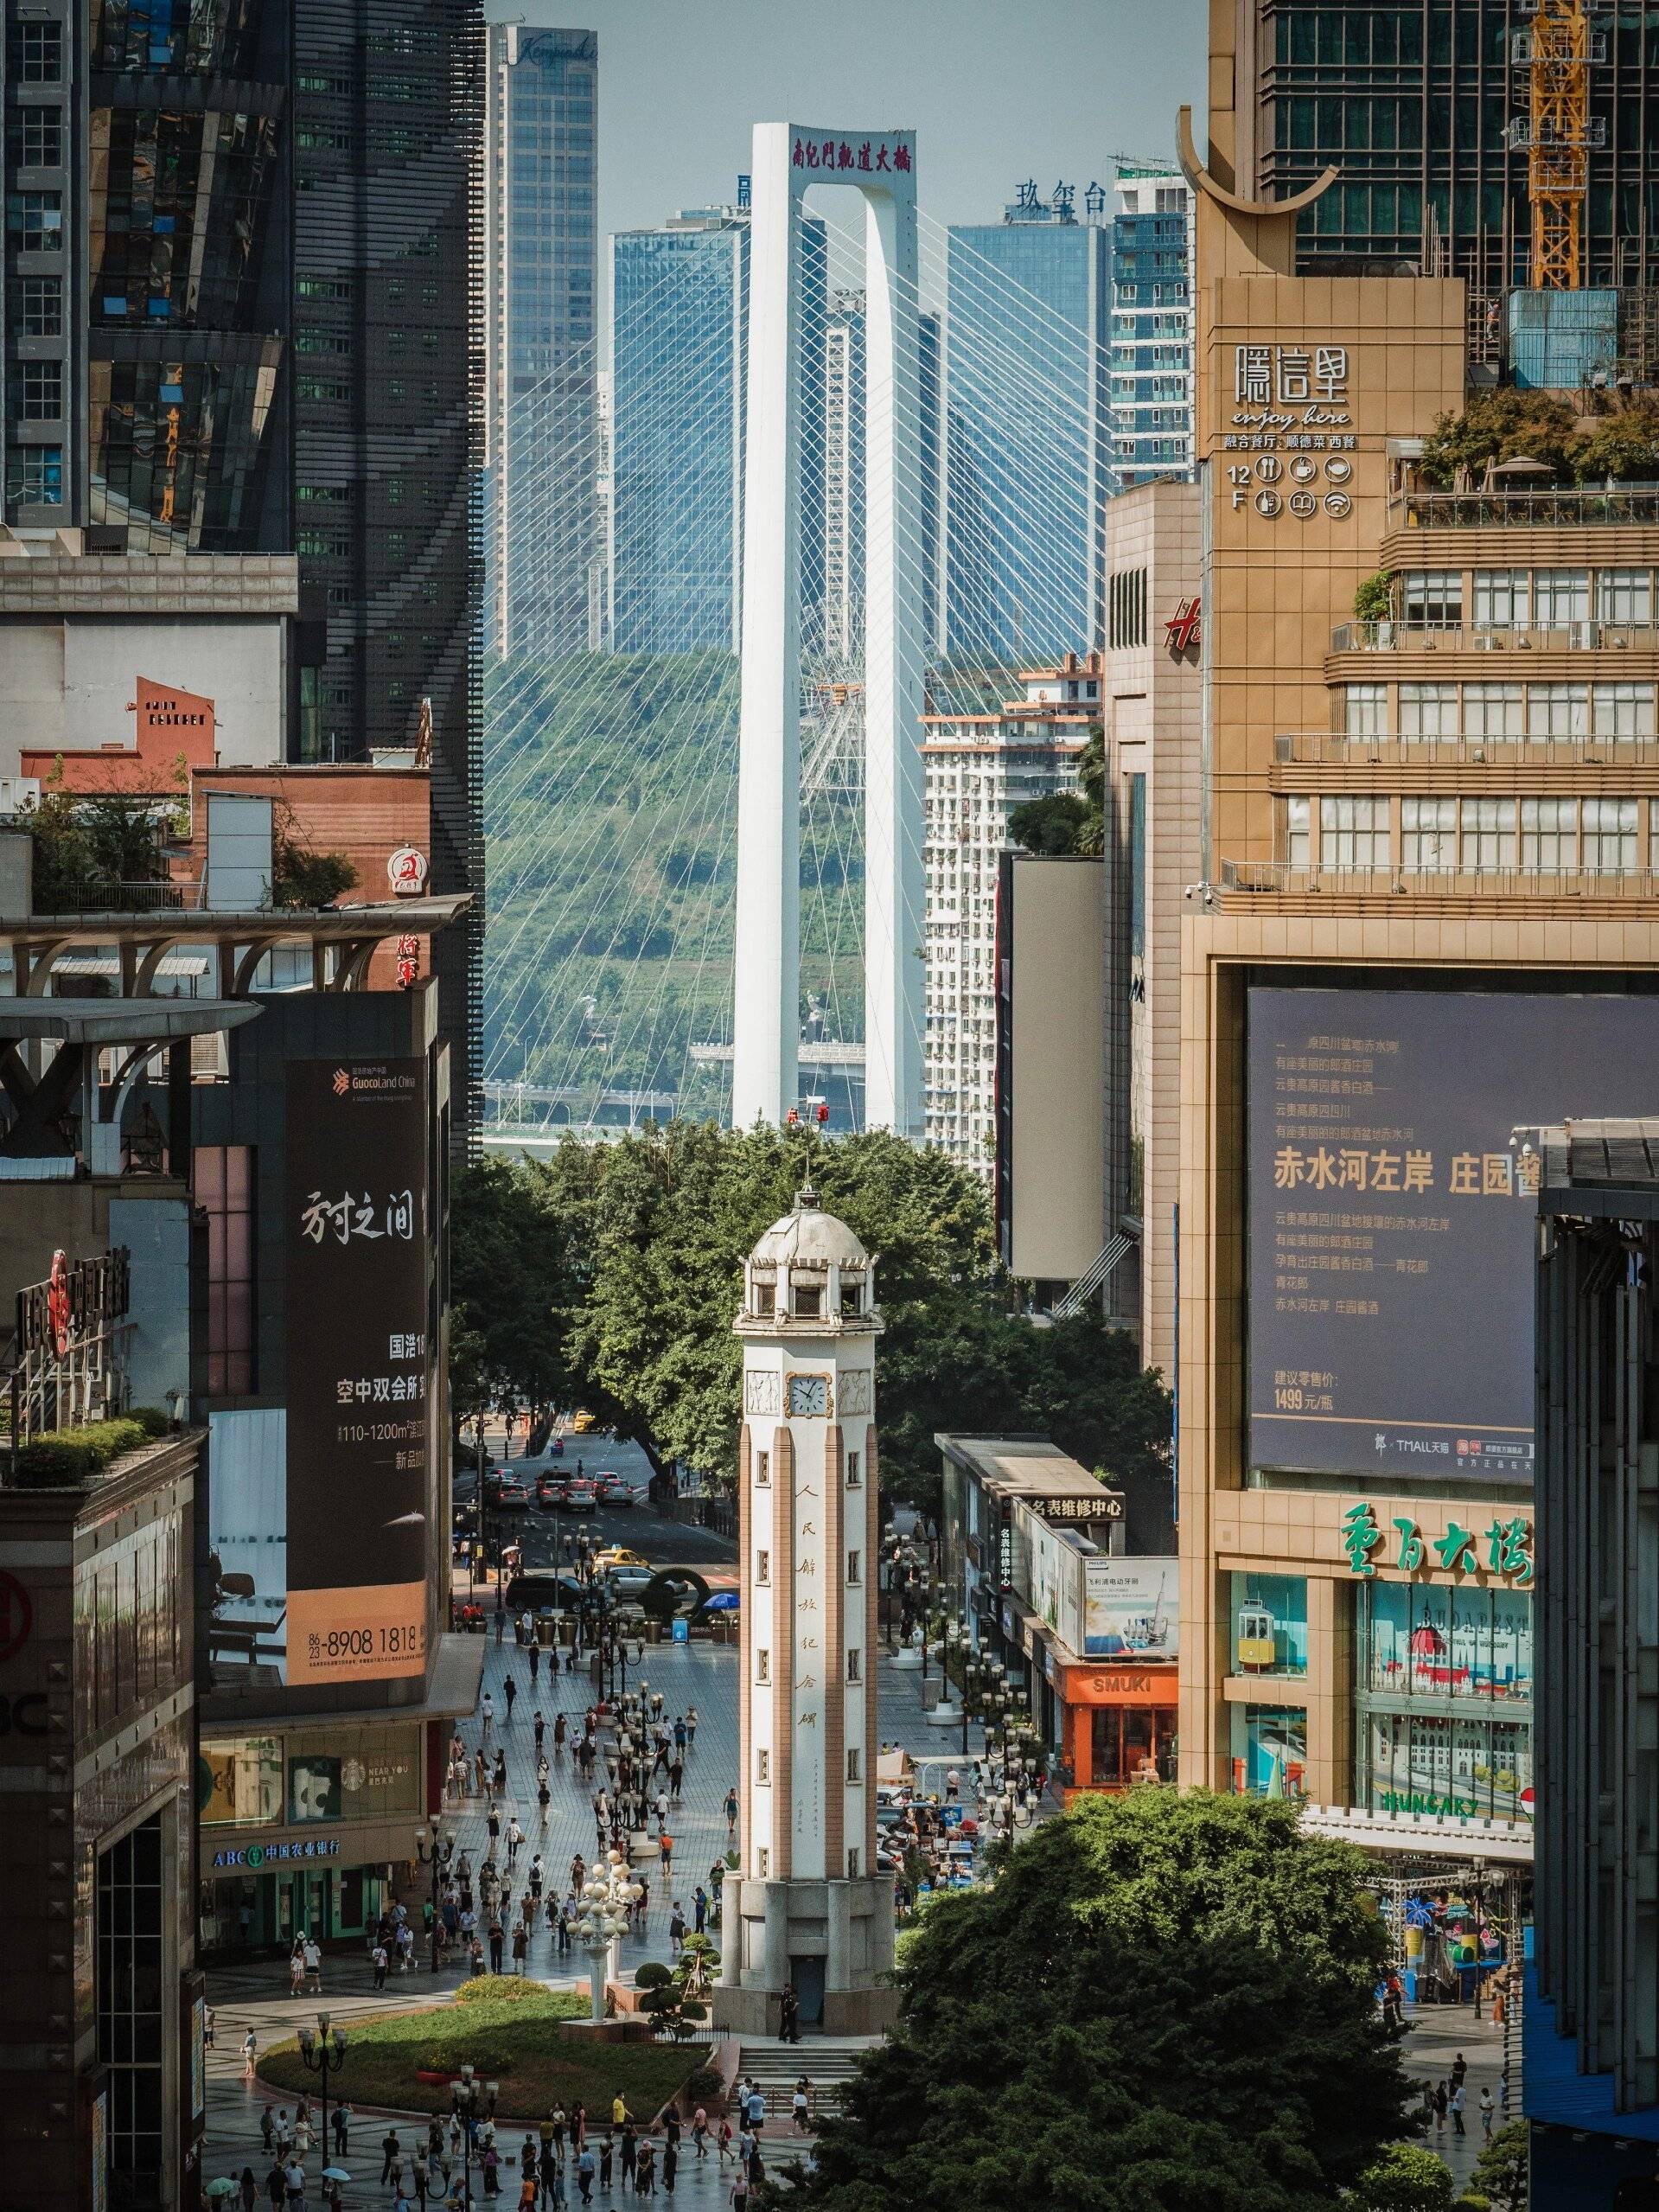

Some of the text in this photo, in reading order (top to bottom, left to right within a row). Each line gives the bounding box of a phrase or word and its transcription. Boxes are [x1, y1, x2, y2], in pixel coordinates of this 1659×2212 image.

[1230, 405, 1350, 432] enjoy here
[1228, 466, 1250, 485] 12
[1231, 490, 1244, 509] F
[353, 1077, 397, 1090] GuocoLand
[1274, 1146, 1434, 1193] 赤水河左岸
[1275, 1299, 1330, 1313] 赤水河左岸
[1032, 1499, 1121, 1518] 名表维修中心
[1000, 1528, 1011, 1587] 名表维修中心
[380, 1626, 416, 1653] 1818
[1094, 1677, 1151, 1692] SMUKI
[368, 1767, 389, 1775] NEAR
[1383, 1791, 1479, 1817] HUNGARY
[214, 1838, 341, 1867] ABC 中国农业银行
